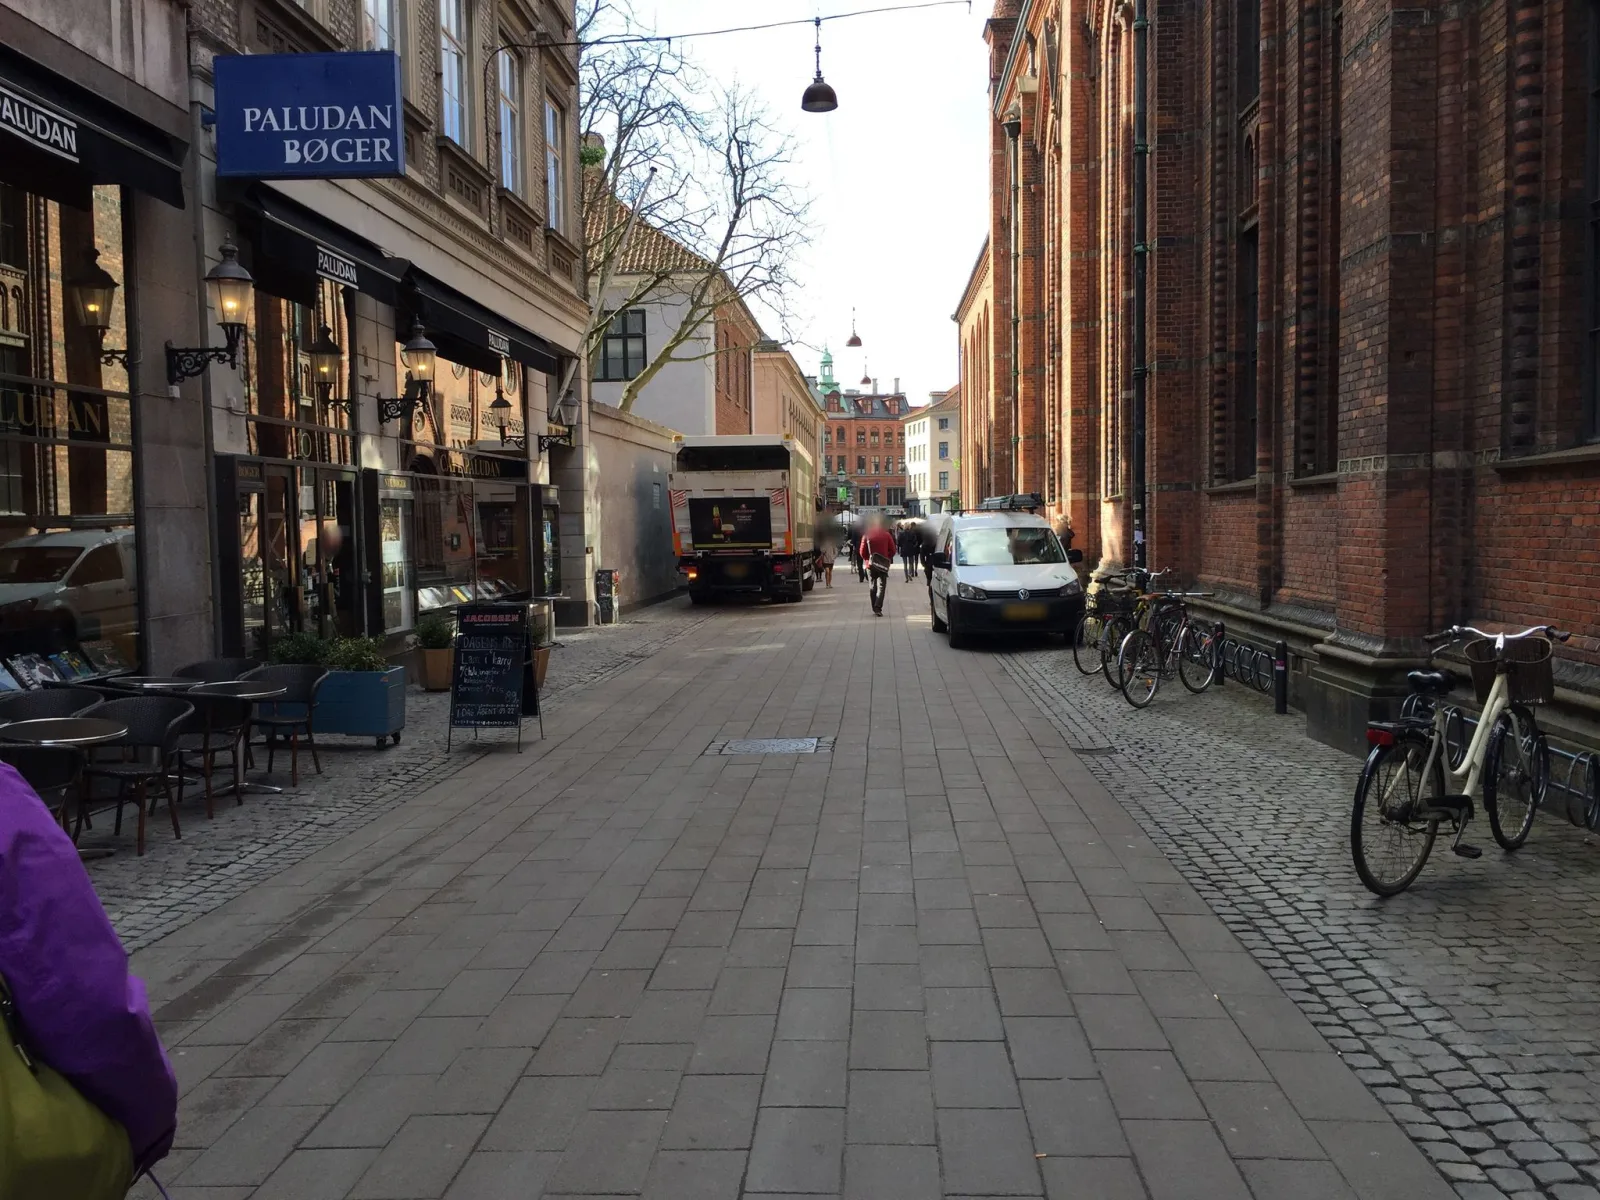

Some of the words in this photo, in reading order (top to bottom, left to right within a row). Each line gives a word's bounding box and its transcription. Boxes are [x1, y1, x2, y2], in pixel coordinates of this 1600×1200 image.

[0, 97, 77, 153] ALUDAN
[243, 105, 393, 132] PALUDAN
[283, 138, 395, 164] BØGER
[318, 251, 358, 283] PALUDAN
[488, 333, 510, 354] PALUDAN
[464, 456, 501, 478] PALUDAN
[463, 613, 520, 623] JACOBSEN
